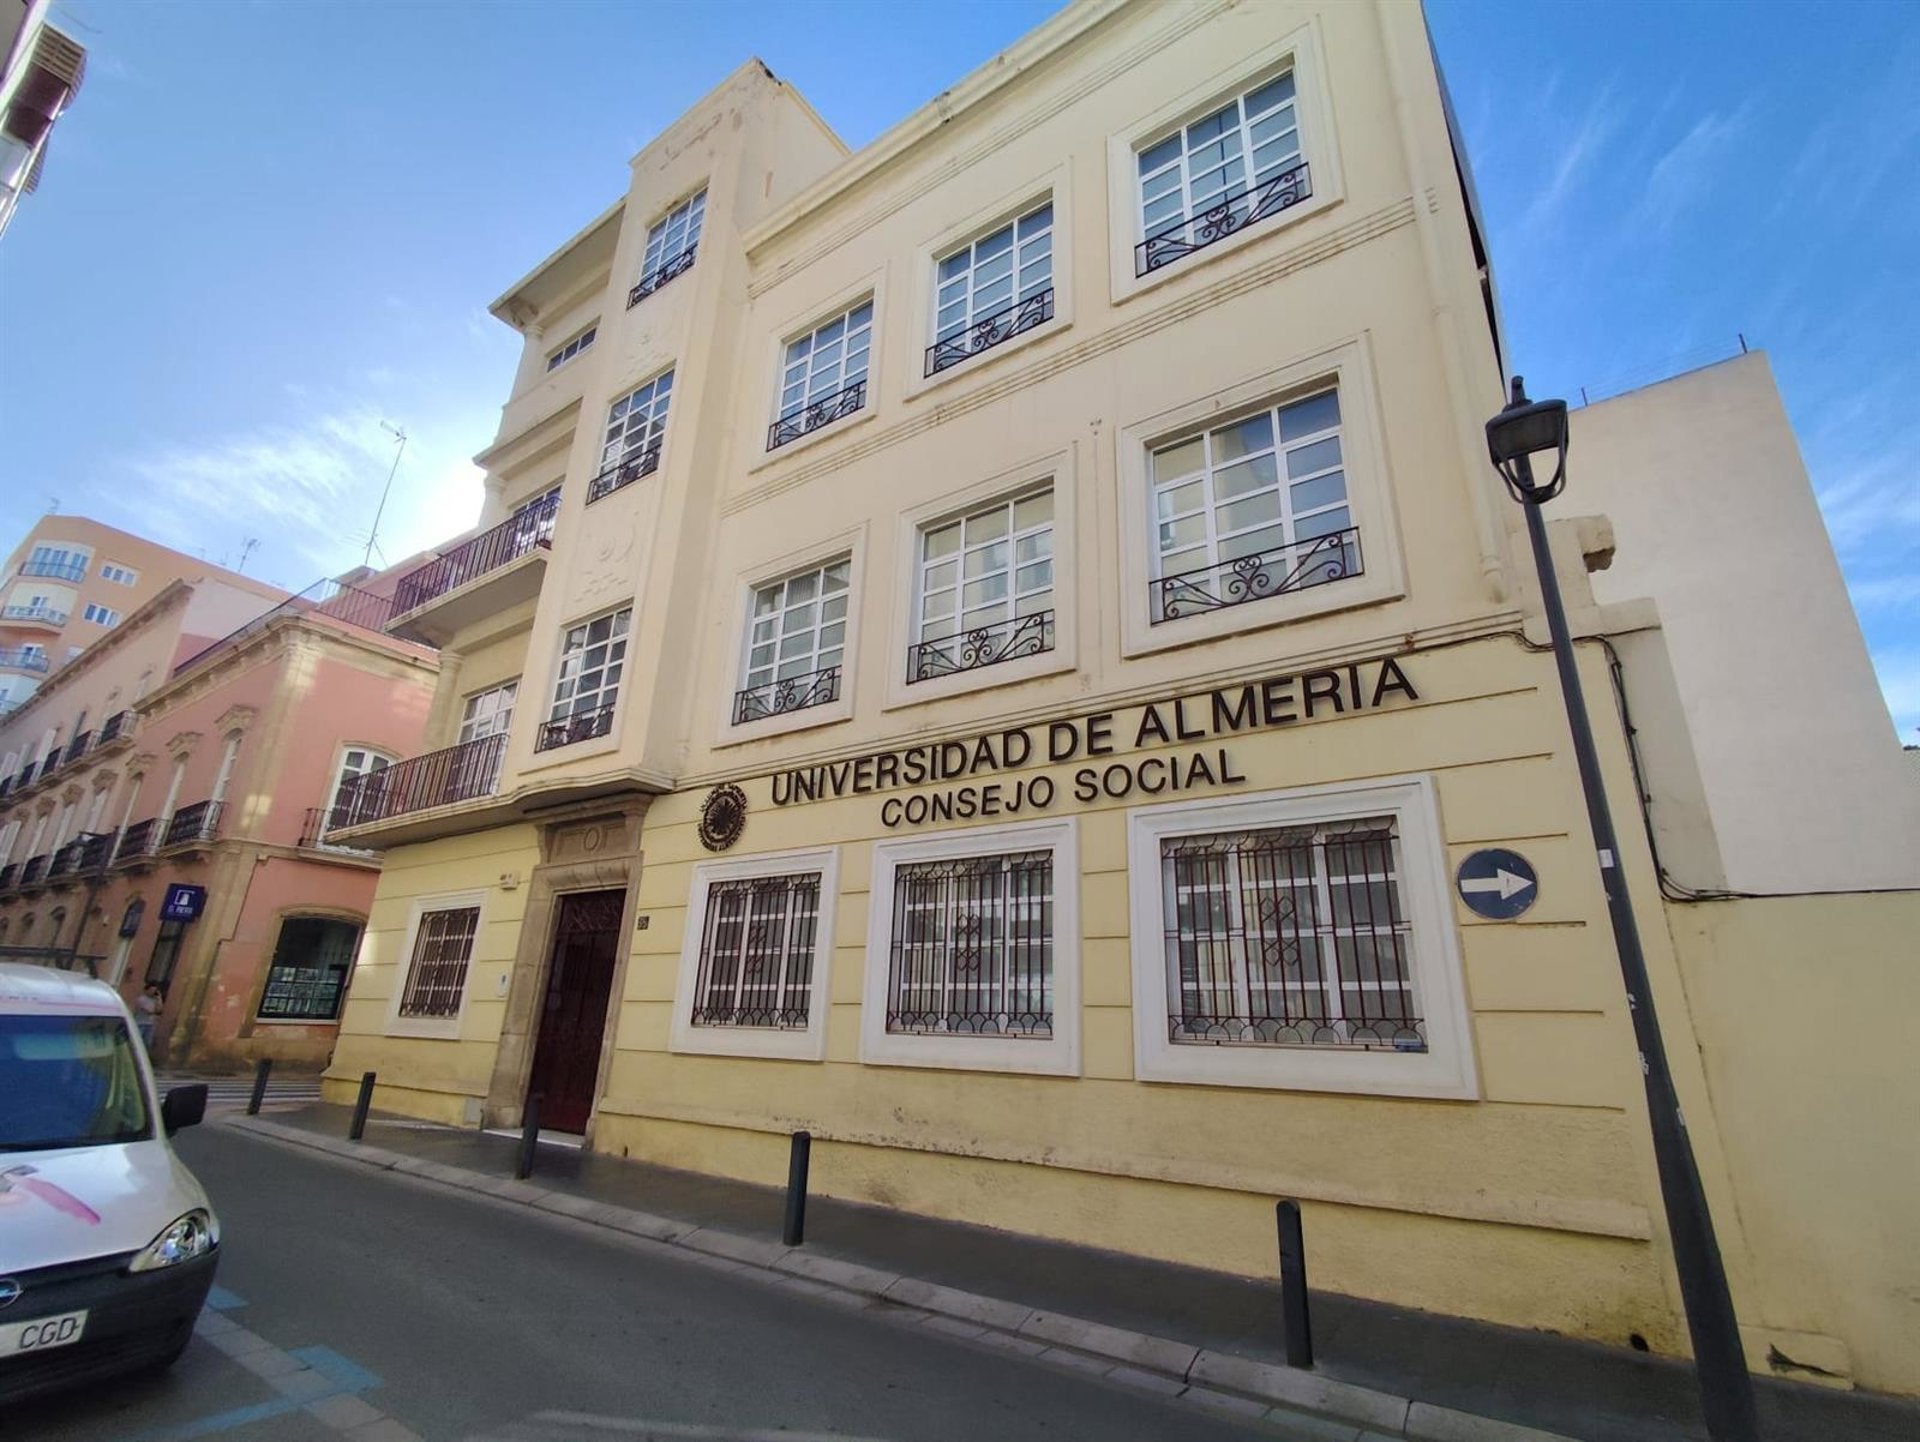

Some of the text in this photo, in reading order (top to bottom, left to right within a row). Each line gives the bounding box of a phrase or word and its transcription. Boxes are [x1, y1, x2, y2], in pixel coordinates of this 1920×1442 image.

[772, 656, 1419, 806] UNIVERSIDAD DE ALMERIA
[881, 749, 1246, 827] CONSEJO SOCIAL
[20, 1317, 80, 1349] CGD
